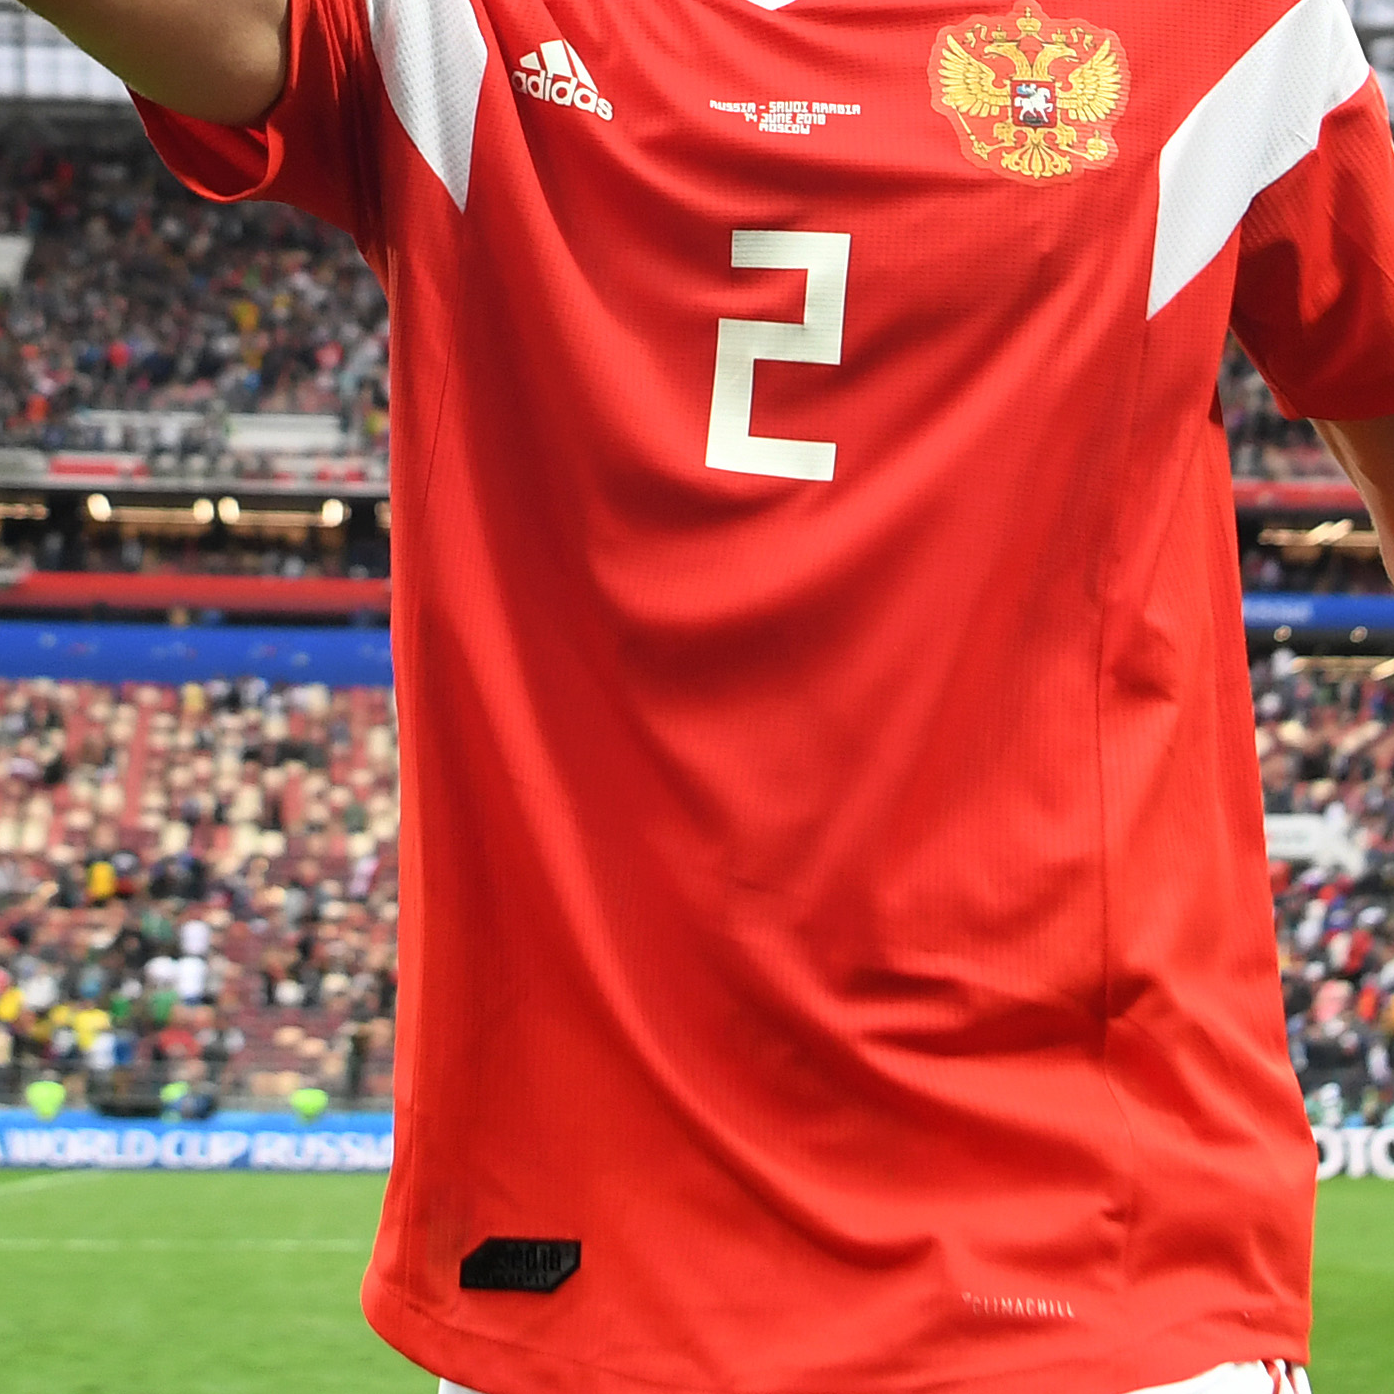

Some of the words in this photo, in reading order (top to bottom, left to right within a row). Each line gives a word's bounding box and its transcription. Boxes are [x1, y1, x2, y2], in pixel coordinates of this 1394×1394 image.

[511, 65, 614, 121] adidas
[709, 99, 756, 114] RUSSIA
[768, 100, 809, 114] SAUDI
[812, 102, 861, 115] ARABIA
[744, 112, 758, 123] 14
[760, 113, 793, 124] JUNE
[795, 114, 826, 126] 2018
[758, 123, 811, 135] MOSCOW
[705, 229, 851, 482] 2
[7, 1127, 157, 1167] WORLD
[159, 1129, 247, 1169] CUP
